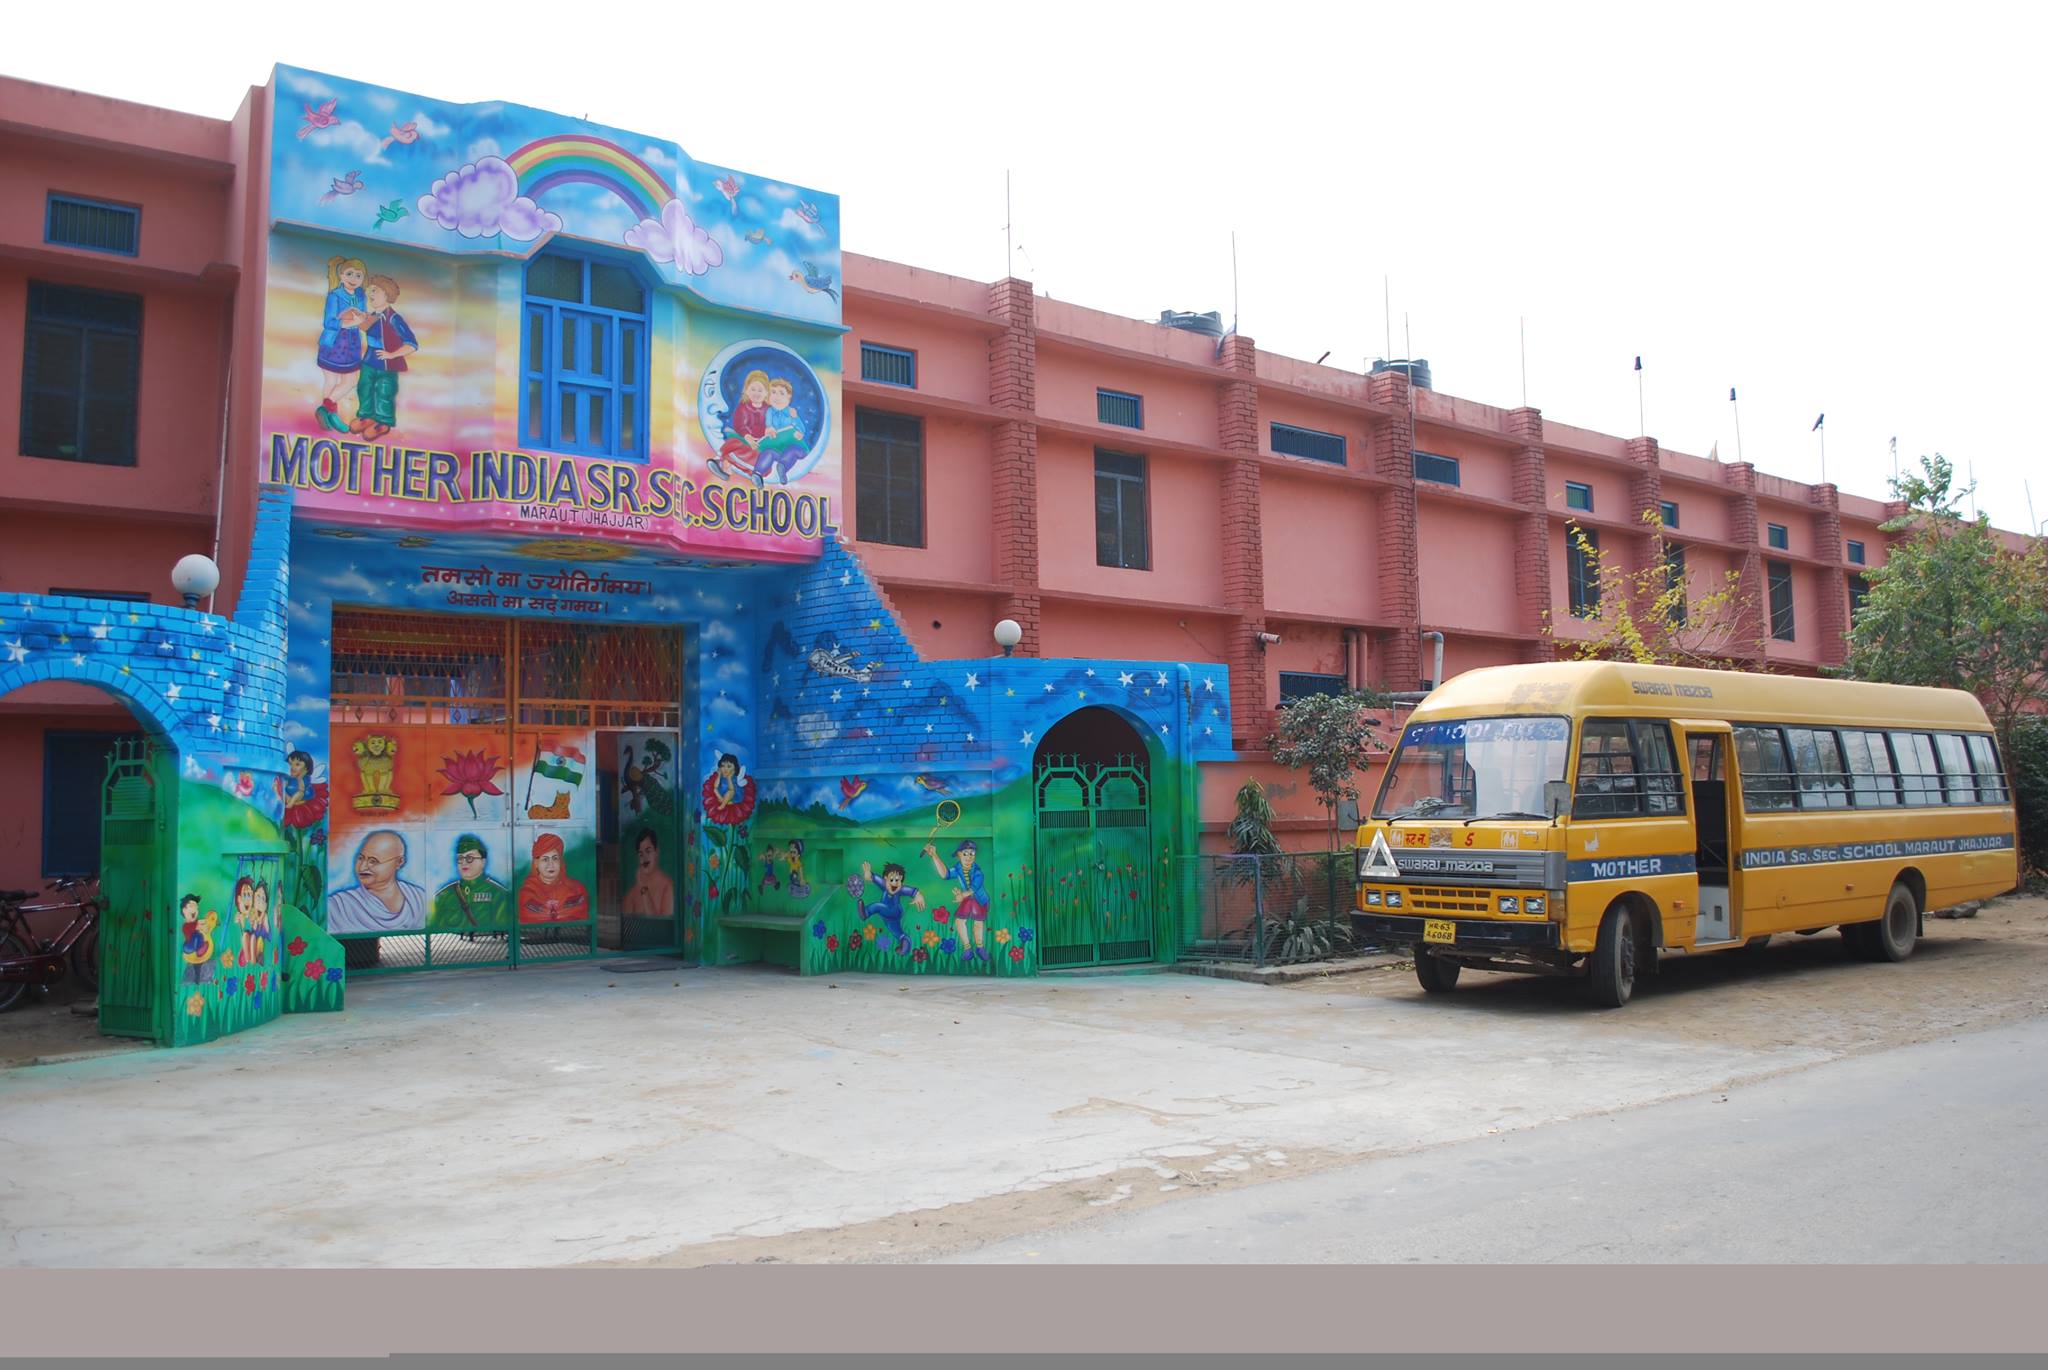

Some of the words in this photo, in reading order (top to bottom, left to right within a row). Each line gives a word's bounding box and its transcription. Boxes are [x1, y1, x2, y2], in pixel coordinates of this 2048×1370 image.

[270, 432, 465, 502] MOTHER
[471, 450, 586, 510] INDIA
[700, 483, 840, 539] SCHOOL
[520, 505, 579, 522] MARAUT
[581, 511, 649, 531] (JHAJJAR)
[420, 565, 493, 586] तमसो
[496, 572, 522, 588] मा
[447, 590, 500, 608] असतो
[502, 595, 525, 609] मा
[1745, 850, 1786, 867] INDIA
[1842, 843, 1901, 859] SCHOOL
[1905, 839, 1956, 854] MARAUT
[1591, 858, 1661, 878] MOTHER
